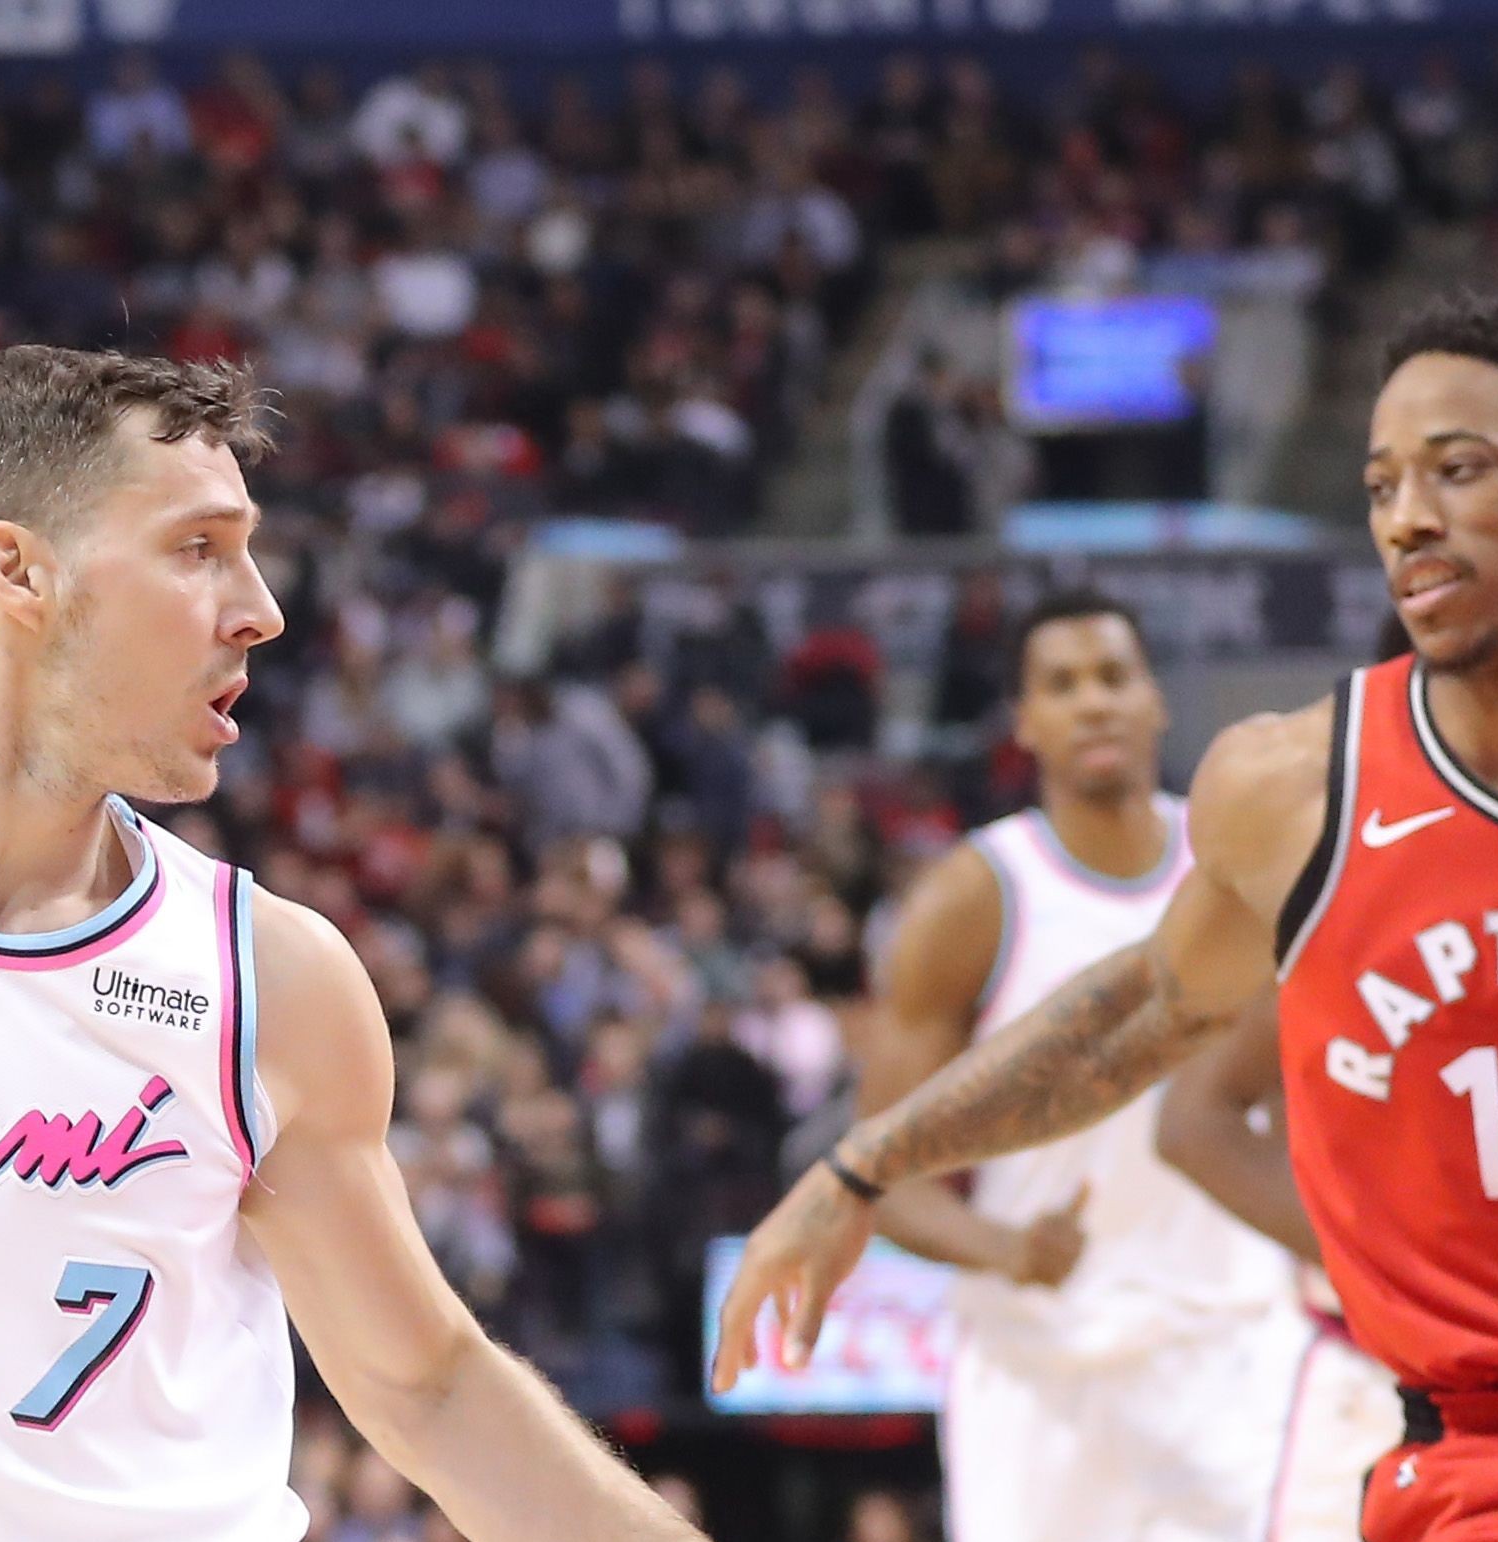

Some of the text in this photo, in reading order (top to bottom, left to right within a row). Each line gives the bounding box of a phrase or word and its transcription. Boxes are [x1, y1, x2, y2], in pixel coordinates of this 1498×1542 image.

[92, 967, 210, 1014] Ultimate
[94, 999, 202, 1031] SOFTWARE
[9, 1260, 155, 1432] 7
